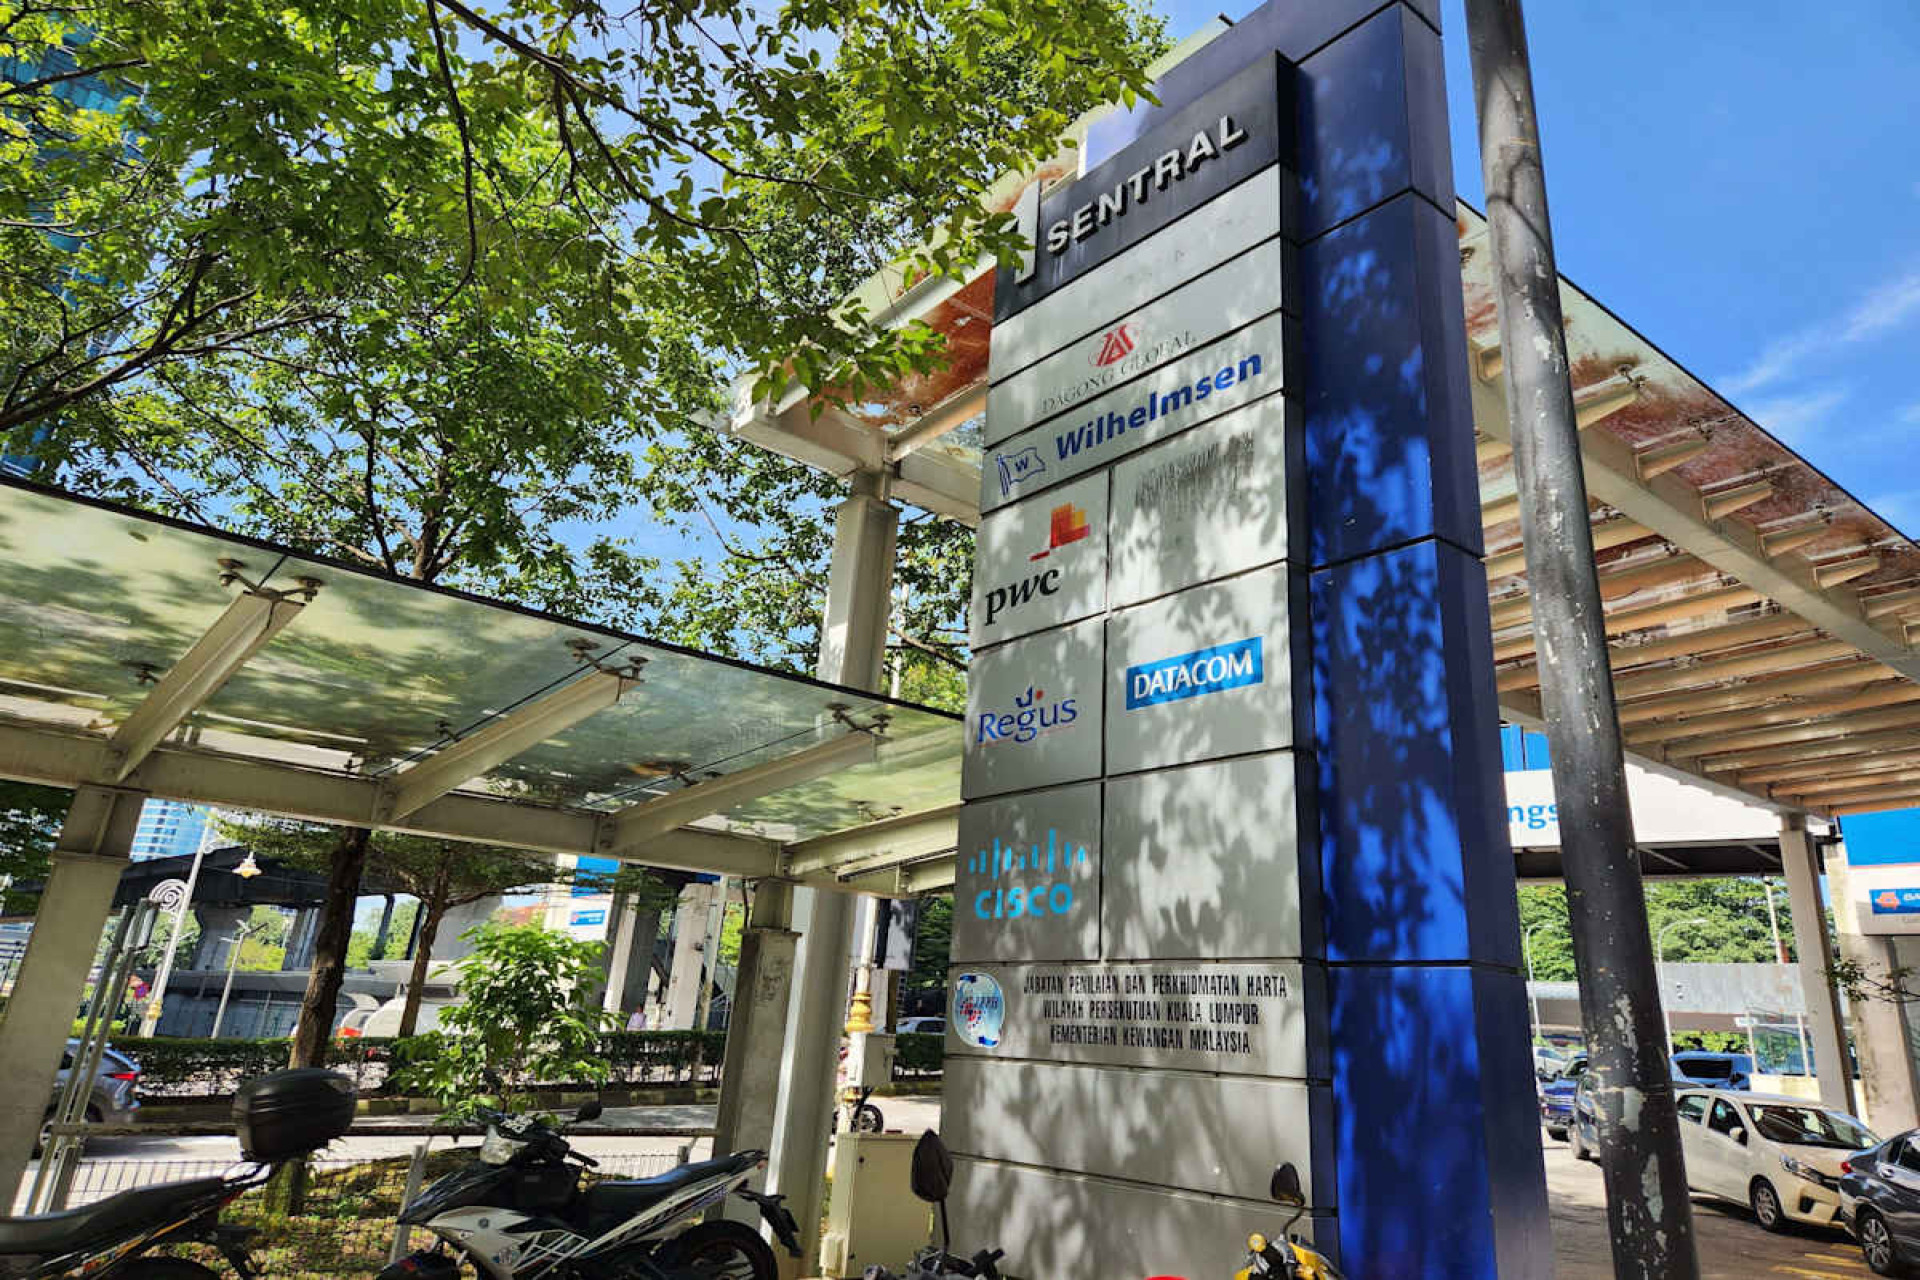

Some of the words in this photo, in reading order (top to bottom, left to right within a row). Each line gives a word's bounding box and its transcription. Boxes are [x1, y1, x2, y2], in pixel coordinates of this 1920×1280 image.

[1047, 115, 1248, 256] SENTRAL
[1056, 354, 1262, 461] Wilhelmsen
[984, 567, 1060, 626] pwc
[1134, 650, 1254, 699] DATACOM
[977, 699, 1077, 743] Regus
[1125, 974, 1146, 995] DAN
[1152, 974, 1240, 997] PERKHIDMATAN
[1247, 975, 1287, 998] HARTA
[1167, 1001, 1202, 1022] KUALA
[1209, 1002, 1259, 1025] LUMPUR
[1122, 1026, 1184, 1049] KEWANGAN
[1189, 1029, 1250, 1053] MALAYSIA
